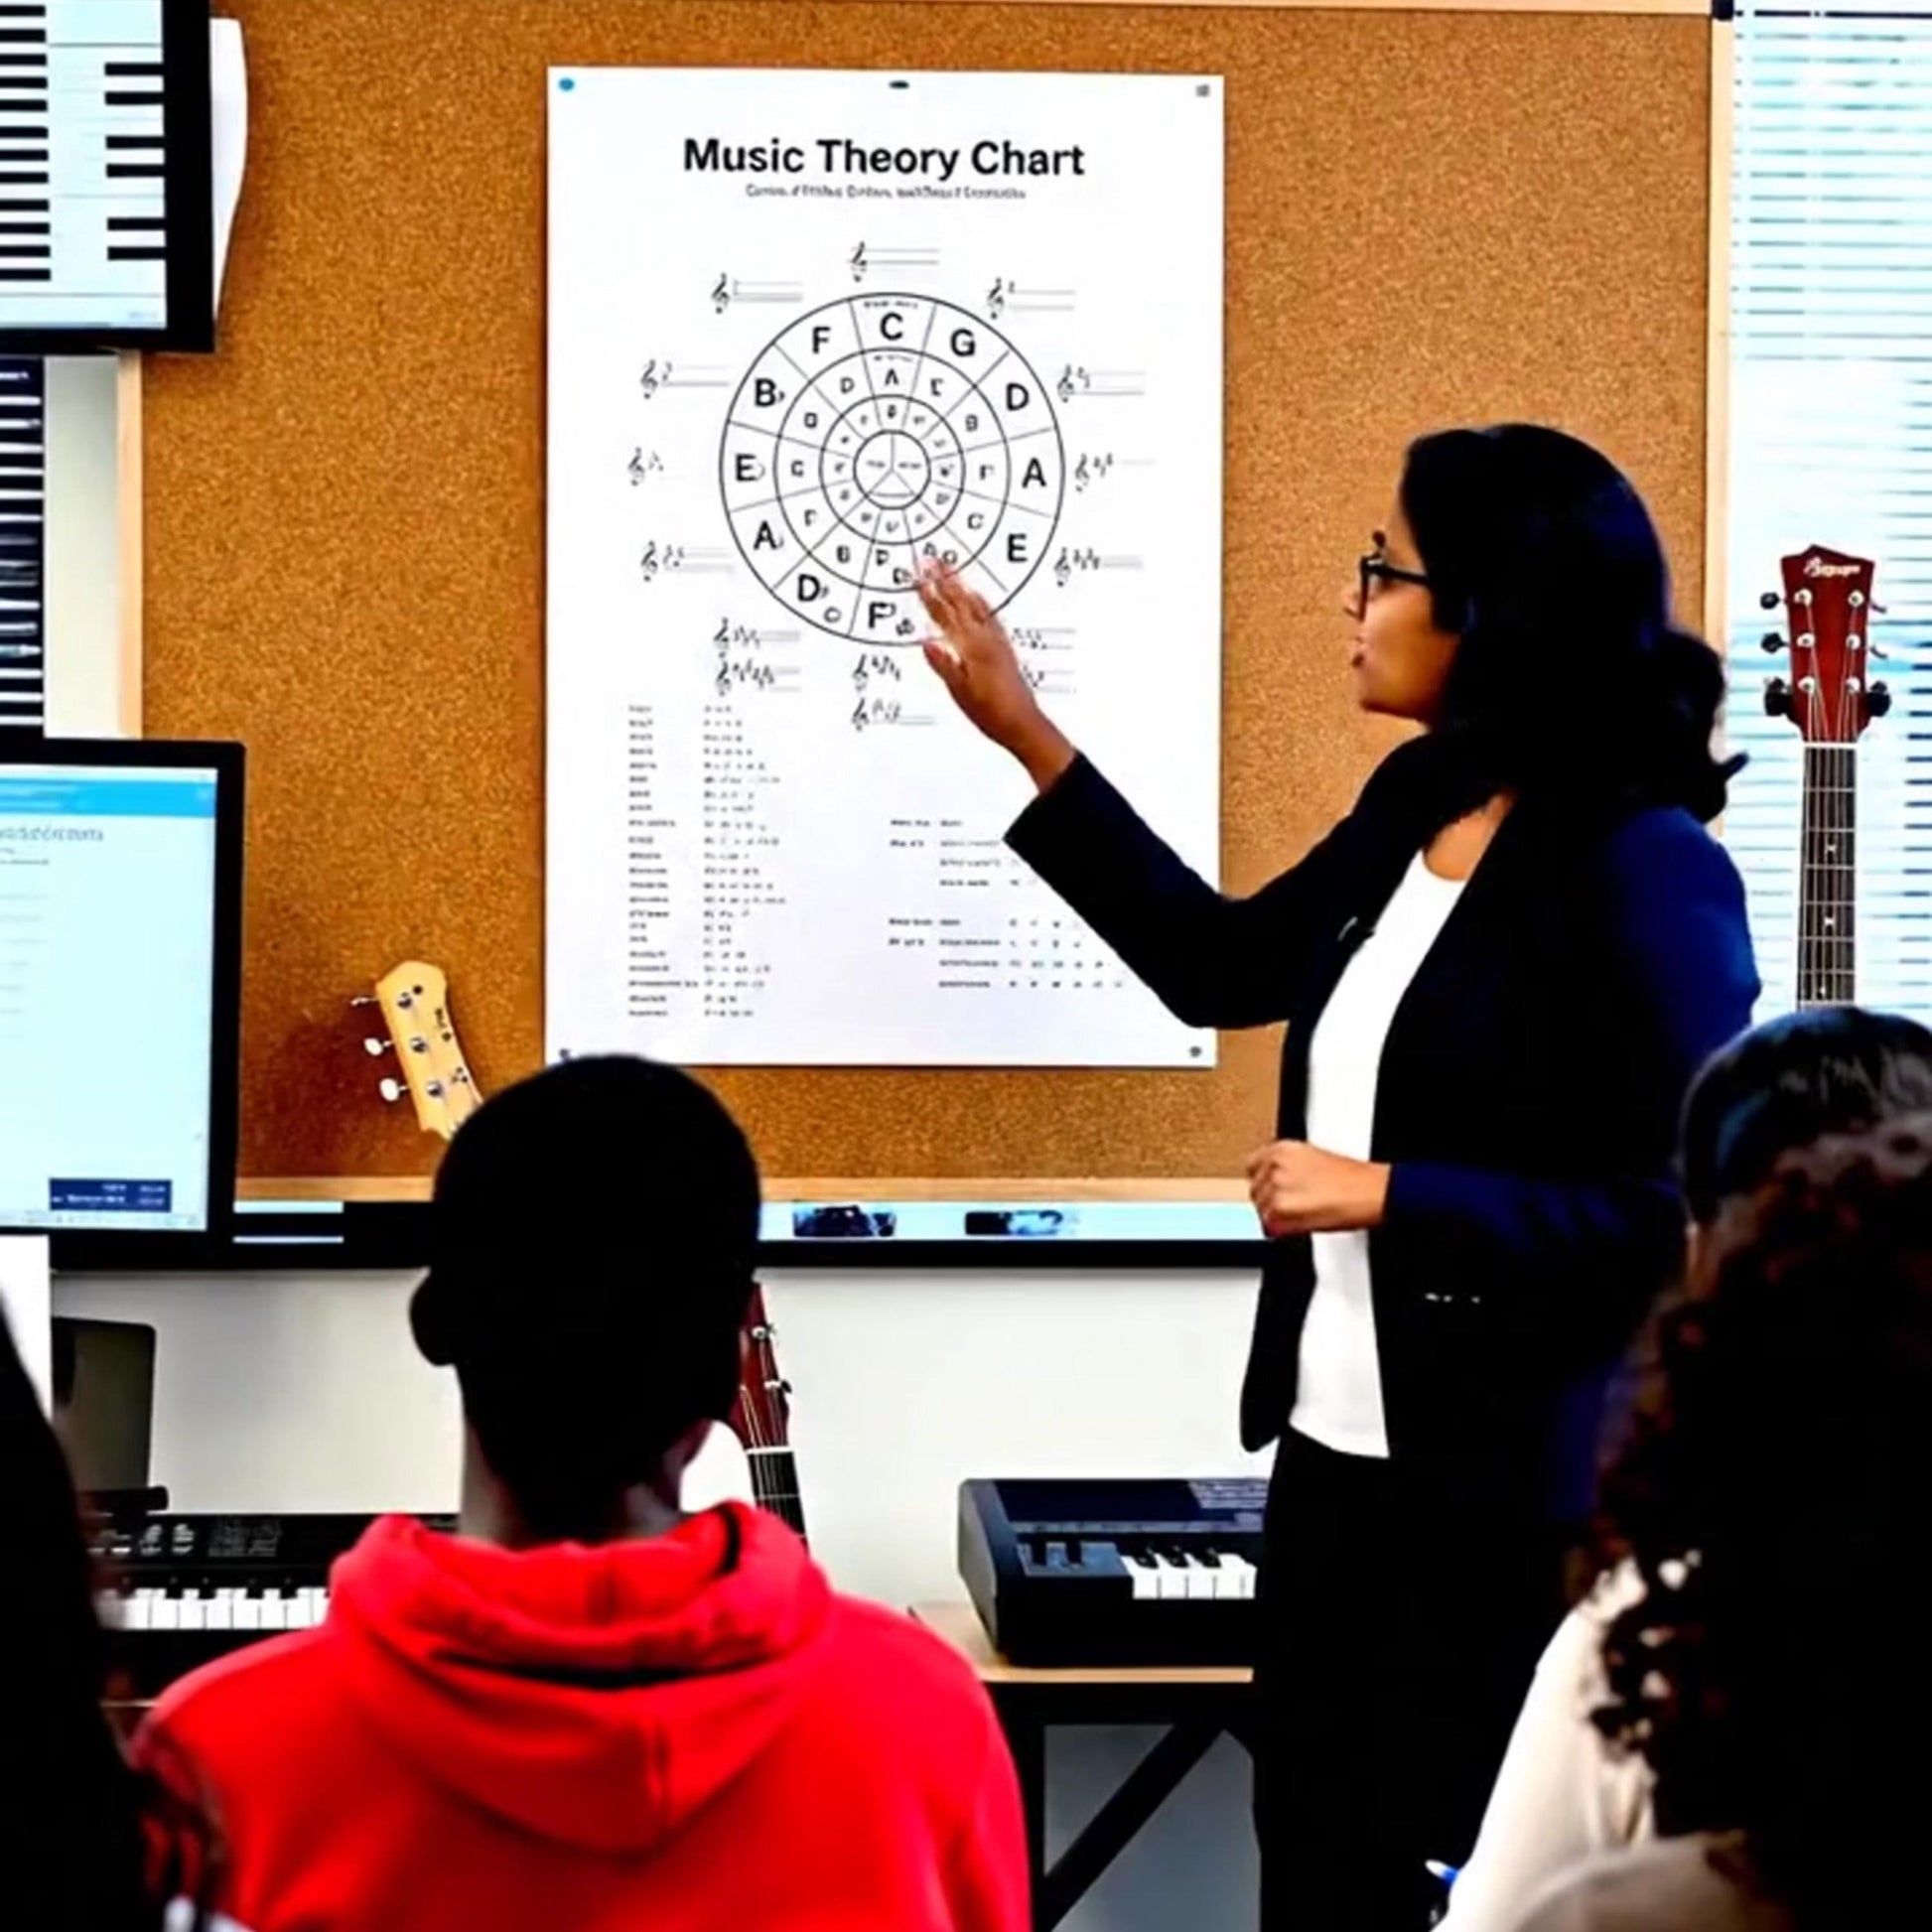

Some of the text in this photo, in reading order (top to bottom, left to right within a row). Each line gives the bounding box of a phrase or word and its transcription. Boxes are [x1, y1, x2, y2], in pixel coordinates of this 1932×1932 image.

[684, 137, 1085, 182] Music Theory Chart
[812, 326, 831, 354] F
[880, 312, 903, 342] C
[950, 328, 976, 357] G
[1006, 382, 1030, 412] D
[1021, 457, 1047, 488] A
[1007, 533, 1029, 563] E
